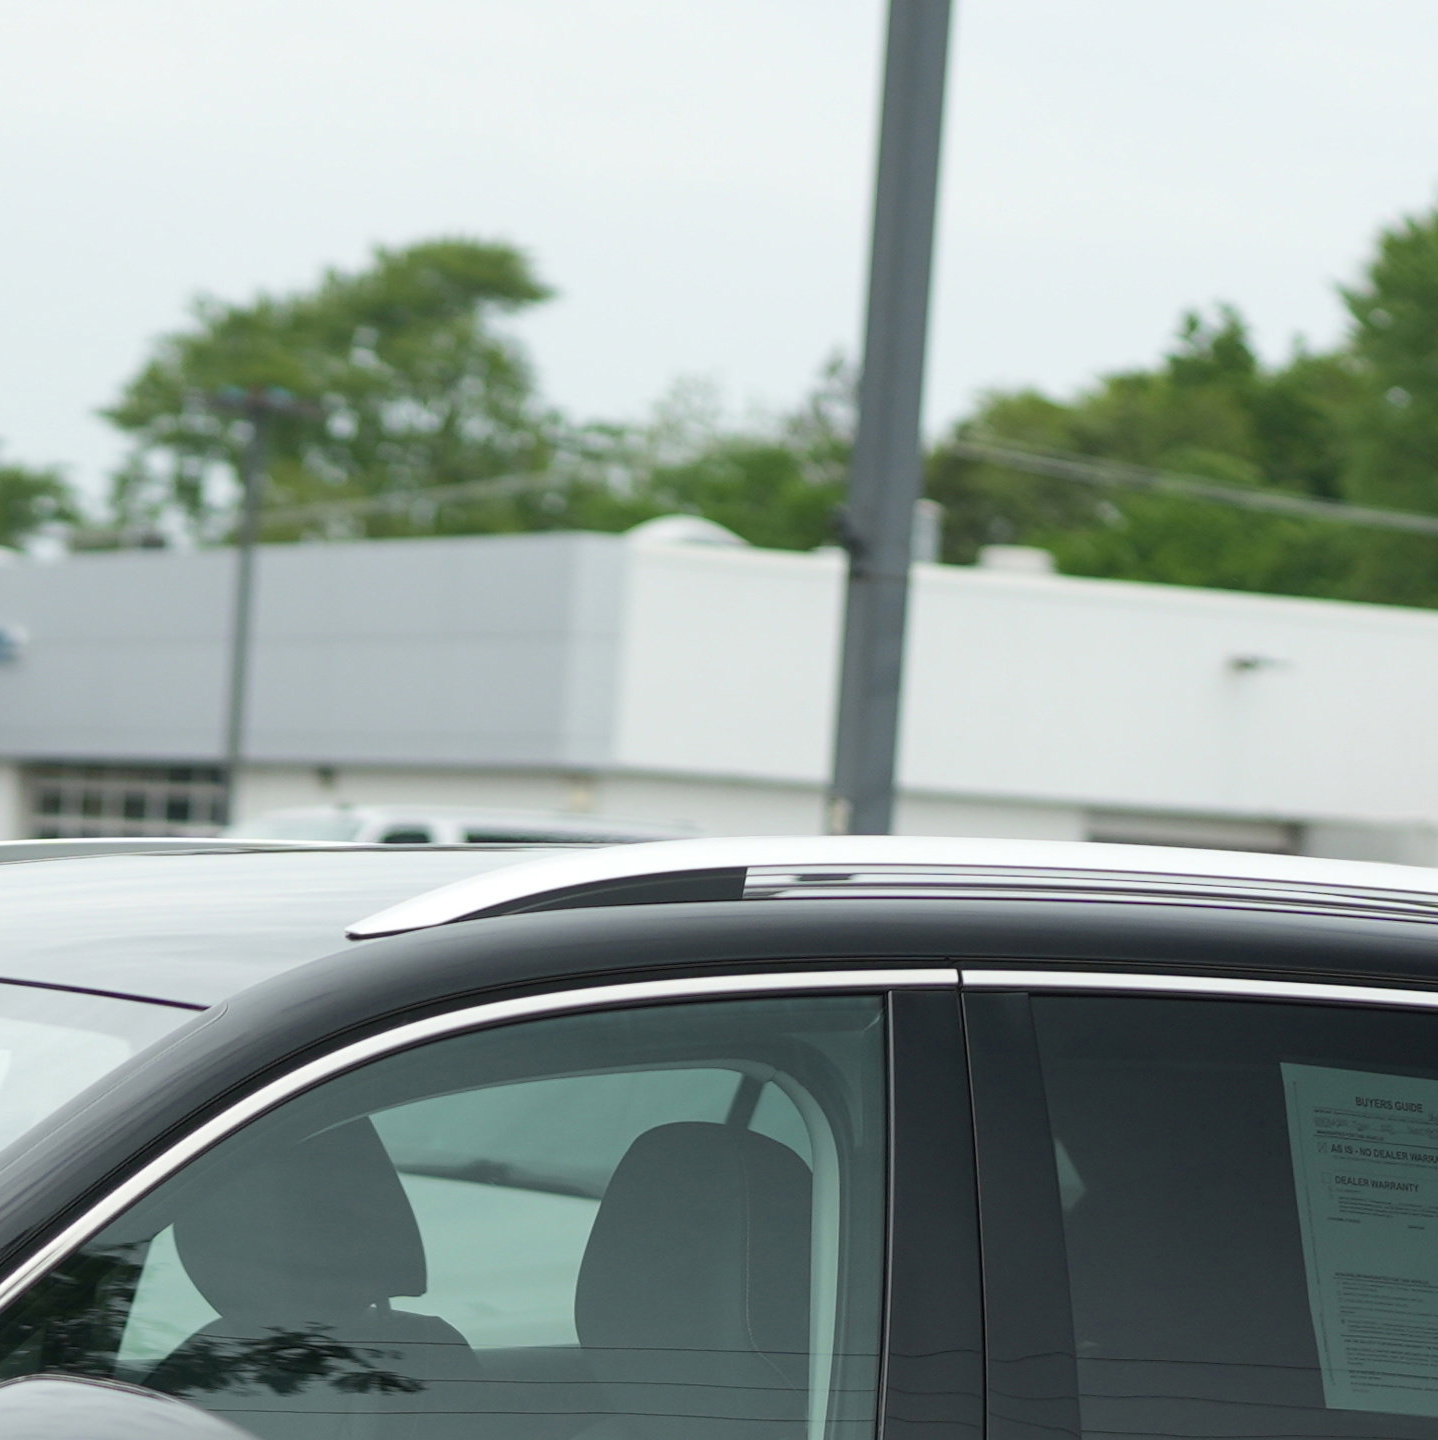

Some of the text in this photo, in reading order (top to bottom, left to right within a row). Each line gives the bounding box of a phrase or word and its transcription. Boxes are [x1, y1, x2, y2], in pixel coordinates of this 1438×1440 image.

[1355, 1096, 1424, 1113] BUYERS GUIDE
[1330, 1143, 1342, 1154] AS
[1344, 1145, 1353, 1155] IS
[1359, 1147, 1372, 1157] NO
[1373, 1149, 1408, 1161] DEALER
[1334, 1175, 1369, 1187] DEALER
[1369, 1178, 1419, 1193] WARRANTY
